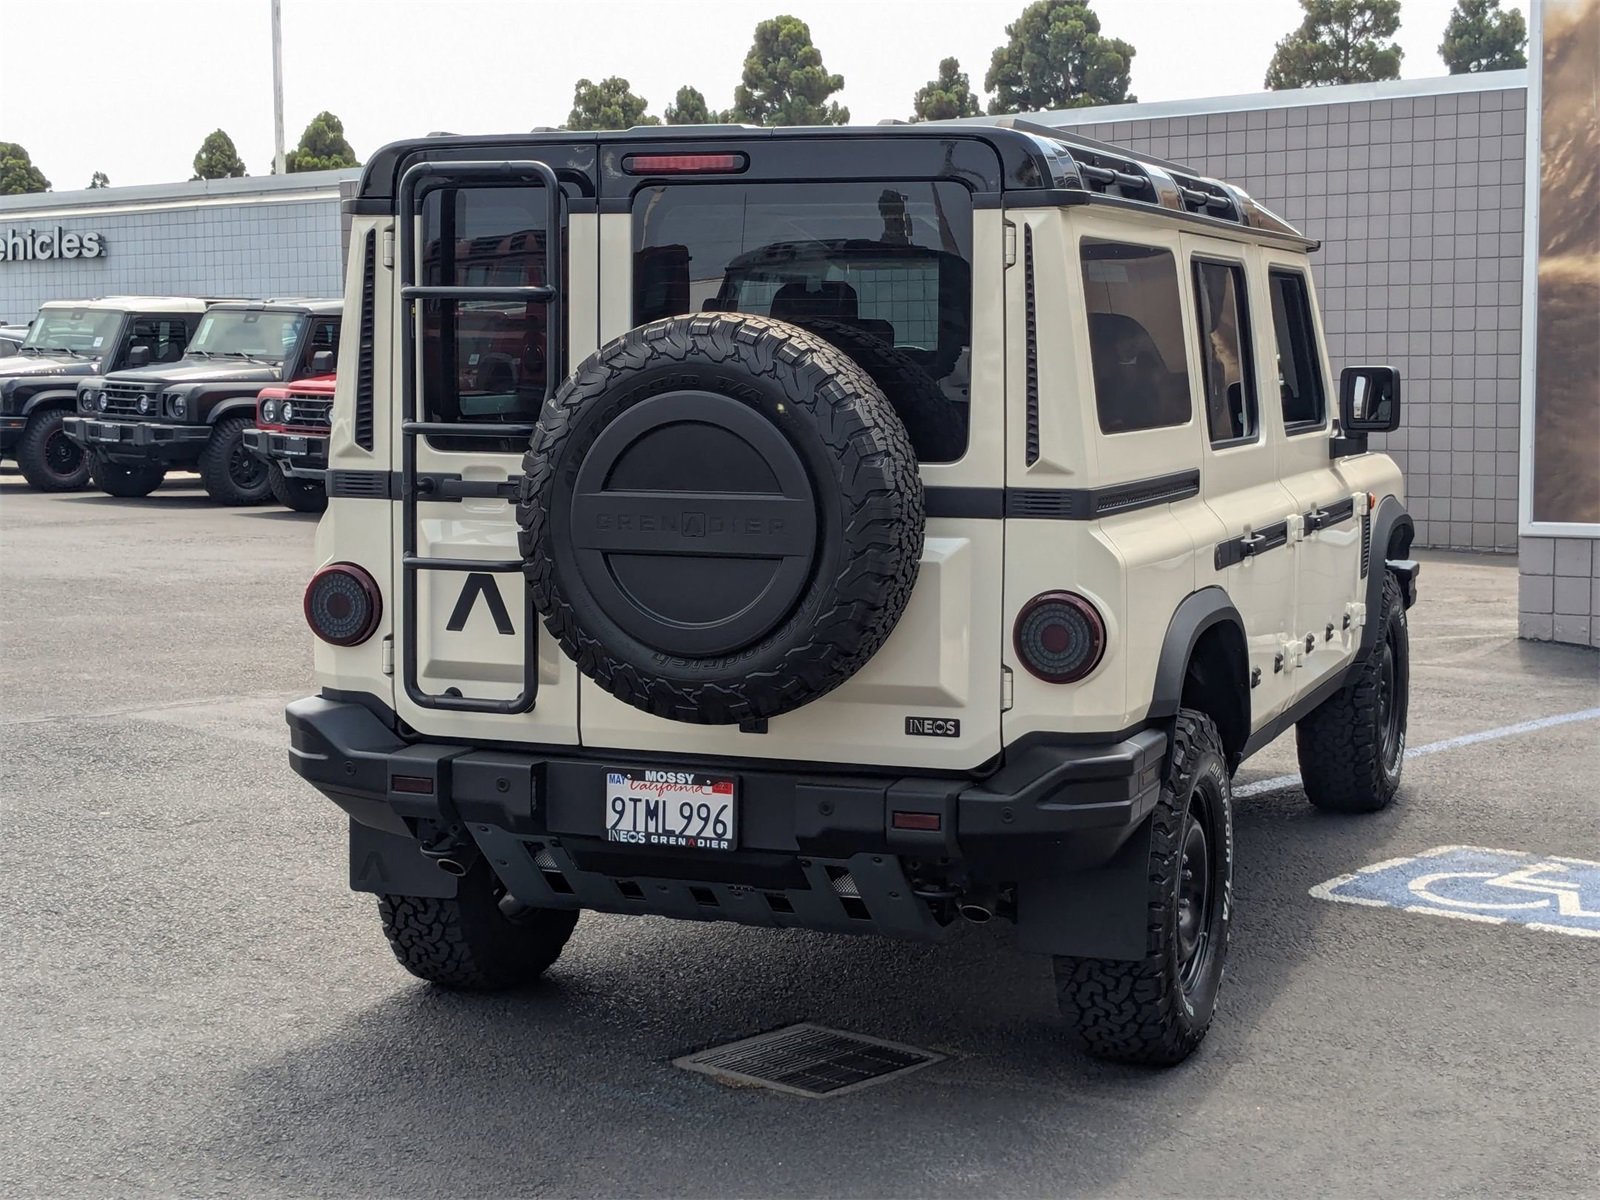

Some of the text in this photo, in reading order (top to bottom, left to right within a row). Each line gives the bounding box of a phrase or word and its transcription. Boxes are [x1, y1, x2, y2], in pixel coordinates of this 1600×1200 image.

[0, 226, 101, 261] hicles
[595, 512, 785, 538] GRENADIER
[909, 719, 956, 735] INEOS
[608, 774, 625, 785] MAY
[645, 770, 695, 785] MOSSY
[629, 779, 713, 798] California
[609, 796, 729, 839] 9TML996
[608, 829, 728, 849] INEOS GRENADIER
